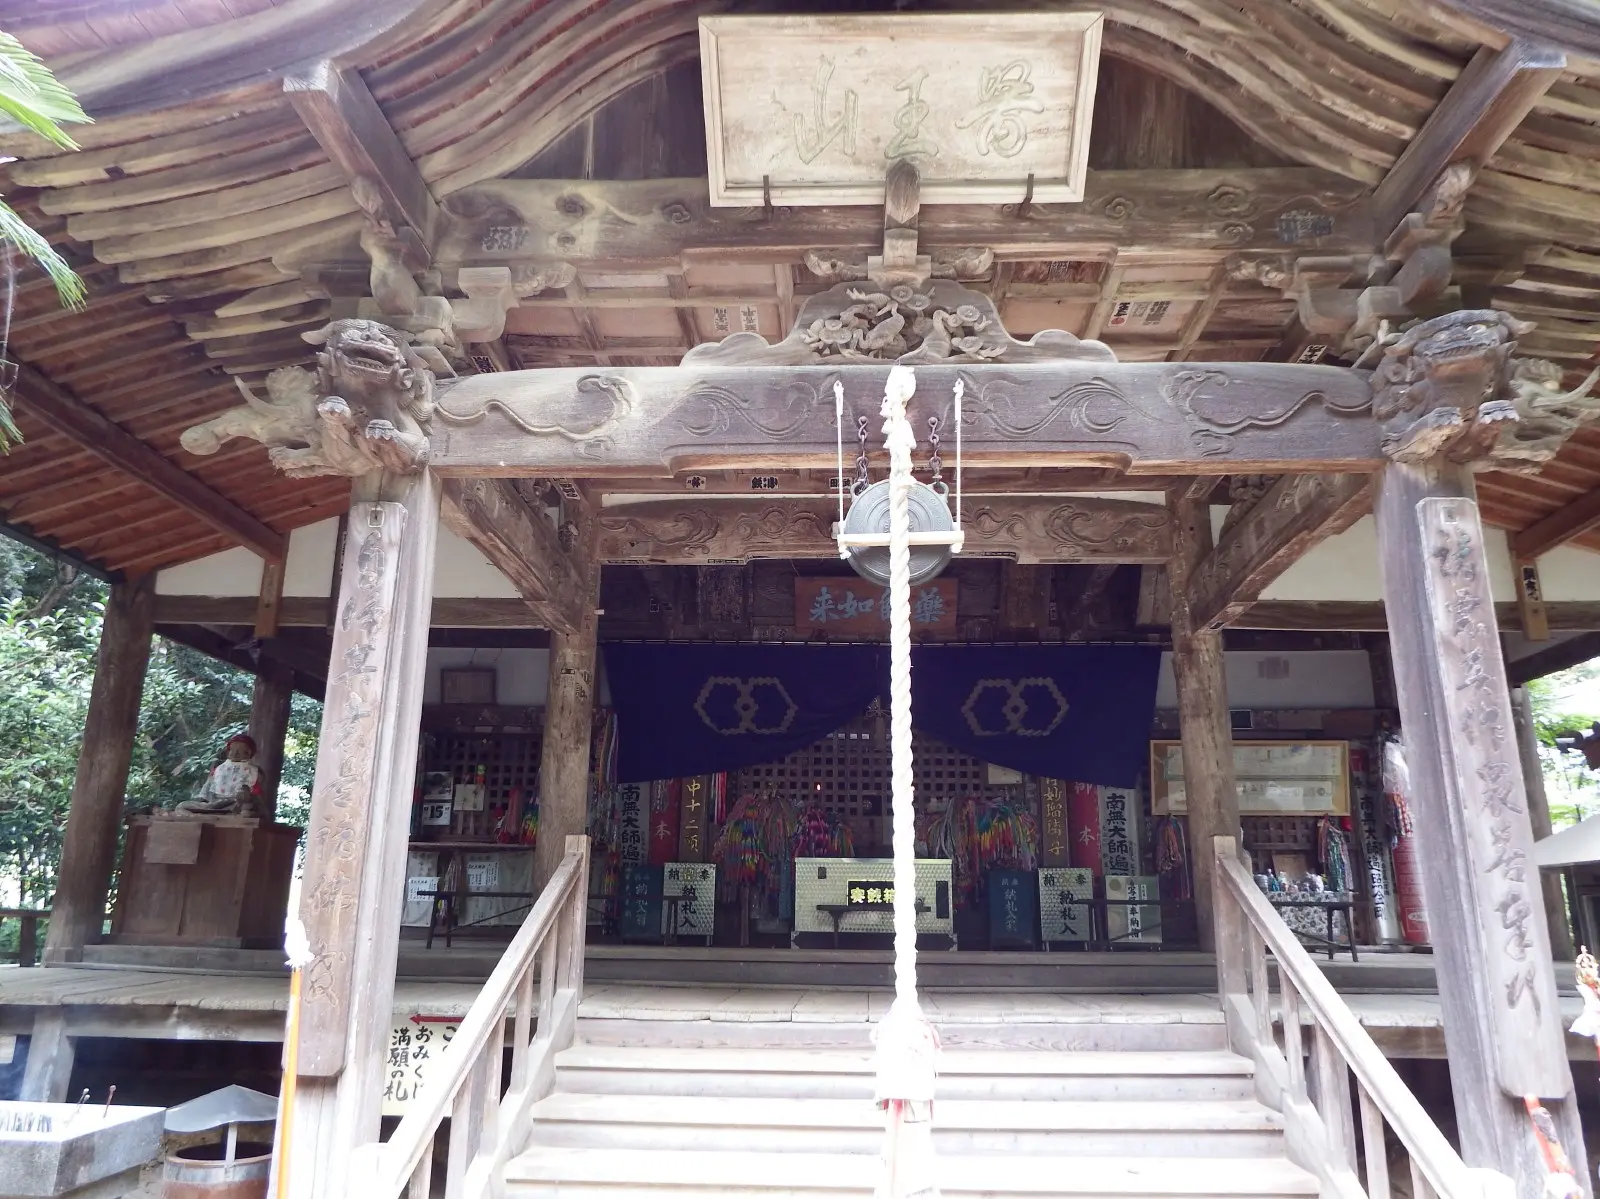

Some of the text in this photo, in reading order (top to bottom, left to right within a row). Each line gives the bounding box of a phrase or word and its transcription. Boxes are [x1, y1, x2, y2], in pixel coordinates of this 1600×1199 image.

[429, 805, 443, 819] 15
[1106, 793, 1129, 876] 南無大師遍
[1059, 890, 1078, 936] 納札入
[383, 1026, 411, 1101] 満願の札
[413, 1026, 433, 1100] おみくじ
